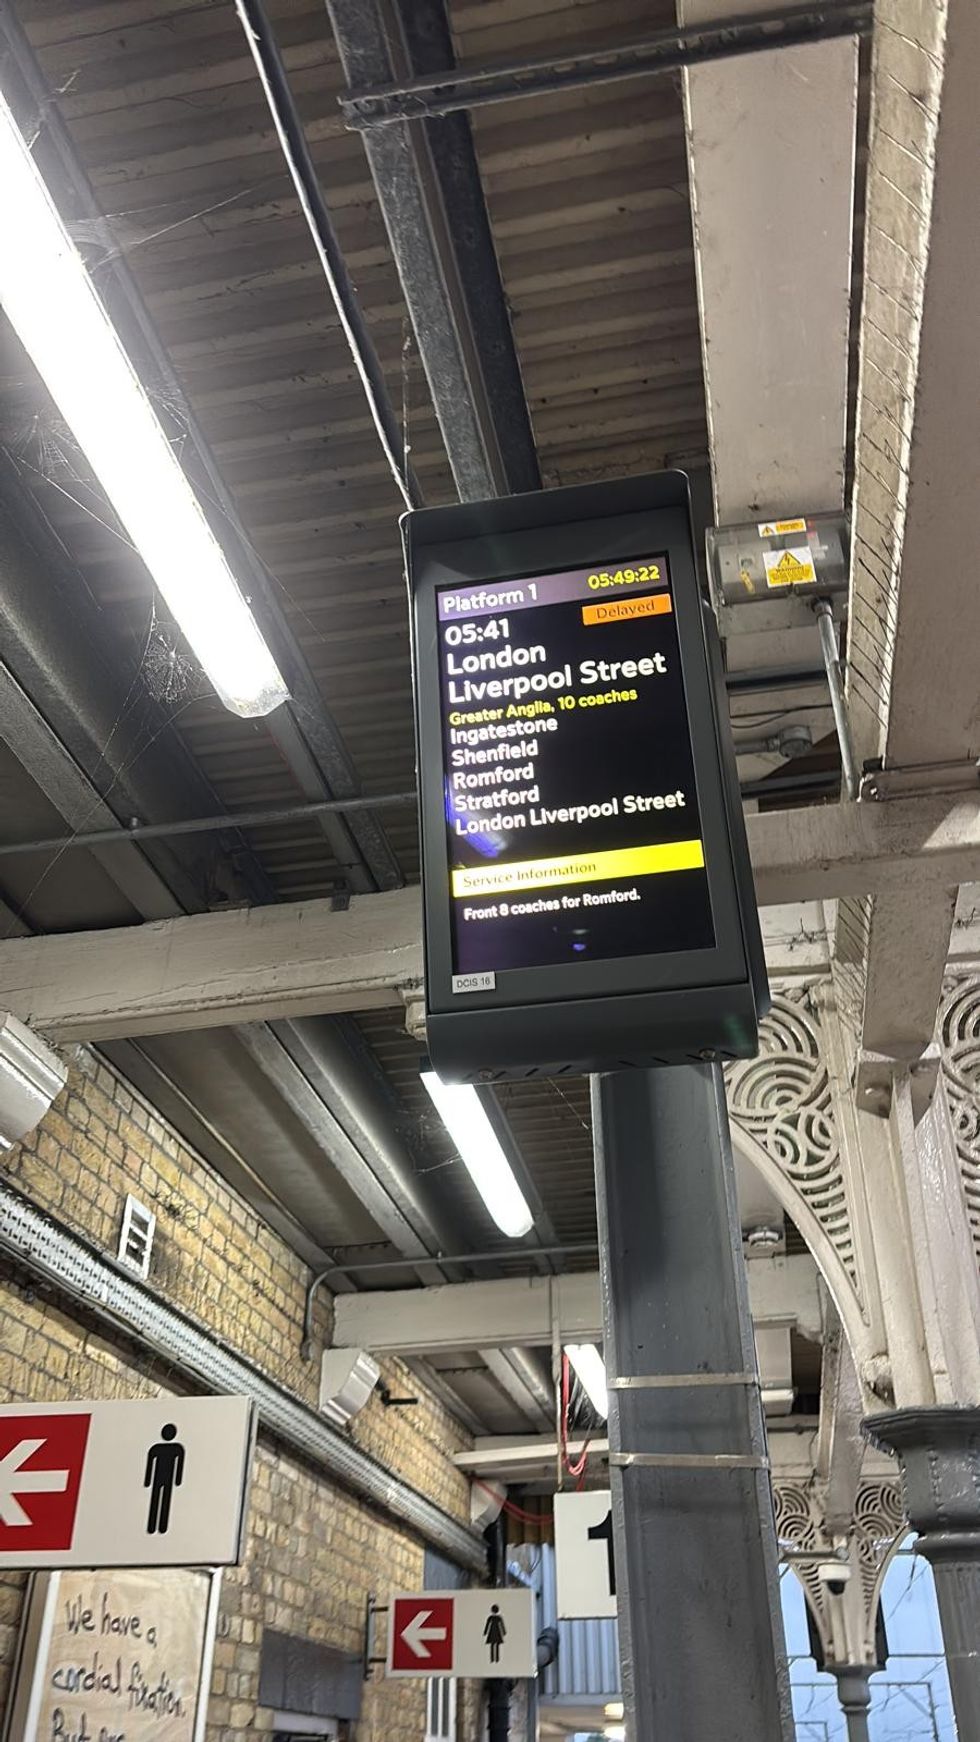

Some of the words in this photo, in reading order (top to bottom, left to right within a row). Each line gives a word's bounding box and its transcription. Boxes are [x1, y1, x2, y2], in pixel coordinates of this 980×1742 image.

[588, 565, 660, 590] 05:49:22
[443, 589, 525, 614] Platform
[527, 583, 537, 601] 1
[596, 600, 656, 620] Delayed
[445, 618, 510, 646] 05:41
[446, 644, 547, 675] London
[448, 664, 572, 703] Liverpool
[579, 652, 668, 684] Street
[449, 708, 504, 726] Greater
[506, 700, 555, 718] Anglia,
[557, 695, 576, 711] 10
[578, 689, 638, 708] coaches
[450, 717, 559, 746] Ingatestone
[451, 739, 539, 767] Shenfield
[453, 762, 535, 789] Romford
[455, 785, 540, 812] Stratford
[455, 813, 526, 836] London
[529, 798, 619, 826] Liverpool
[623, 790, 686, 814] Street
[463, 872, 513, 888] Service
[517, 862, 597, 881] Information
[464, 907, 498, 921] Front
[500, 904, 509, 917] 8
[511, 896, 560, 916] coaches
[561, 895, 581, 909] for
[583, 887, 641, 906] Romford.
[456, 977, 479, 989] DCIS
[481, 976, 491, 988] 16
[66, 1593, 95, 1635] We
[101, 1592, 142, 1638] have
[52, 1651, 121, 1696] cordial
